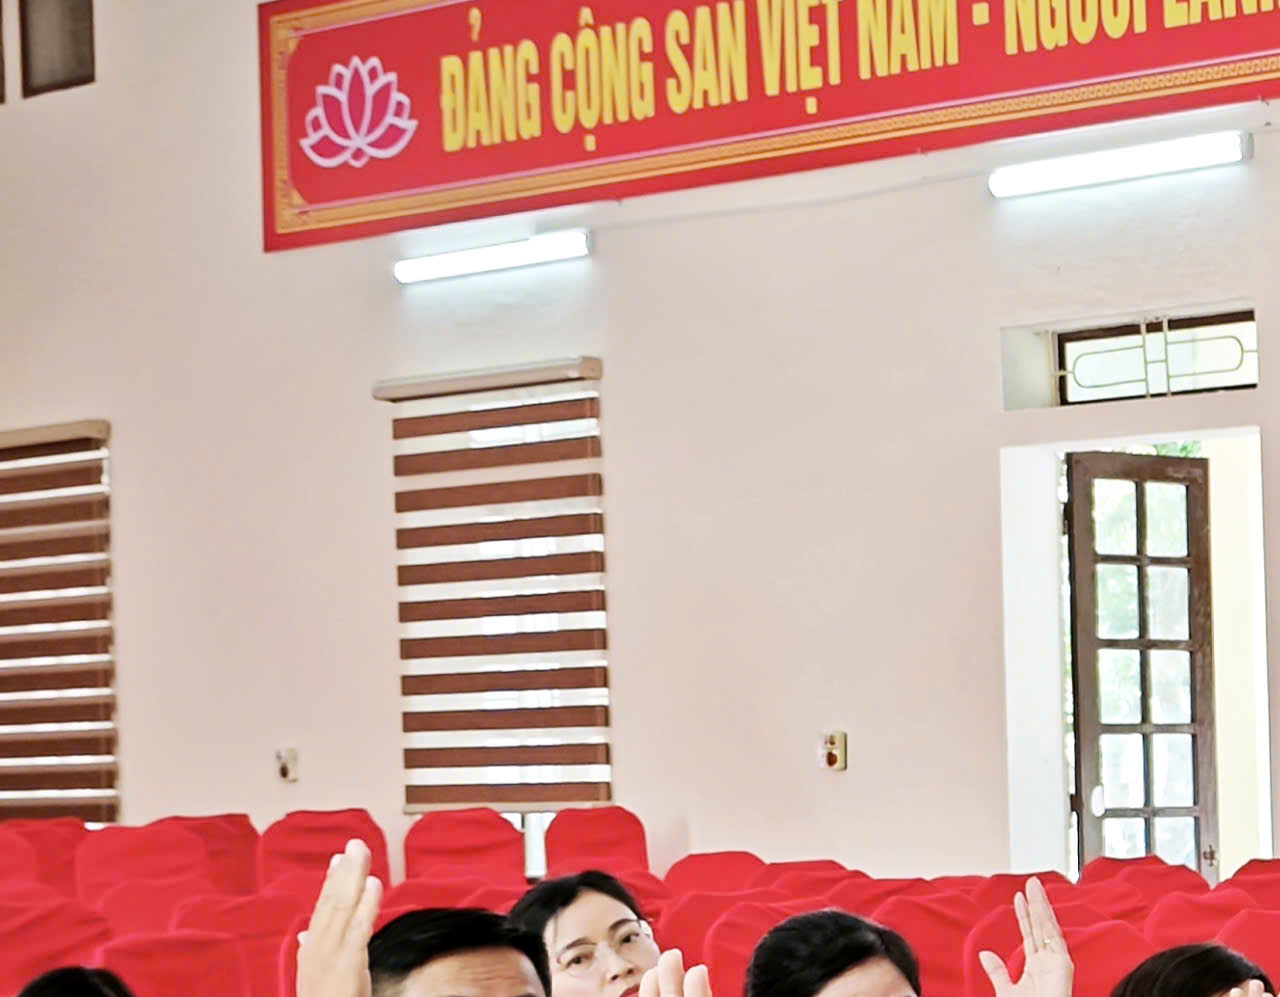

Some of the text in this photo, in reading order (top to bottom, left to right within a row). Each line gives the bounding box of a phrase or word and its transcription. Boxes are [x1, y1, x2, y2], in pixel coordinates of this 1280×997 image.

[440, 7, 542, 151] ĐẢNG
[551, 6, 656, 151] CỘNG
[857, 0, 959, 80] NAM
